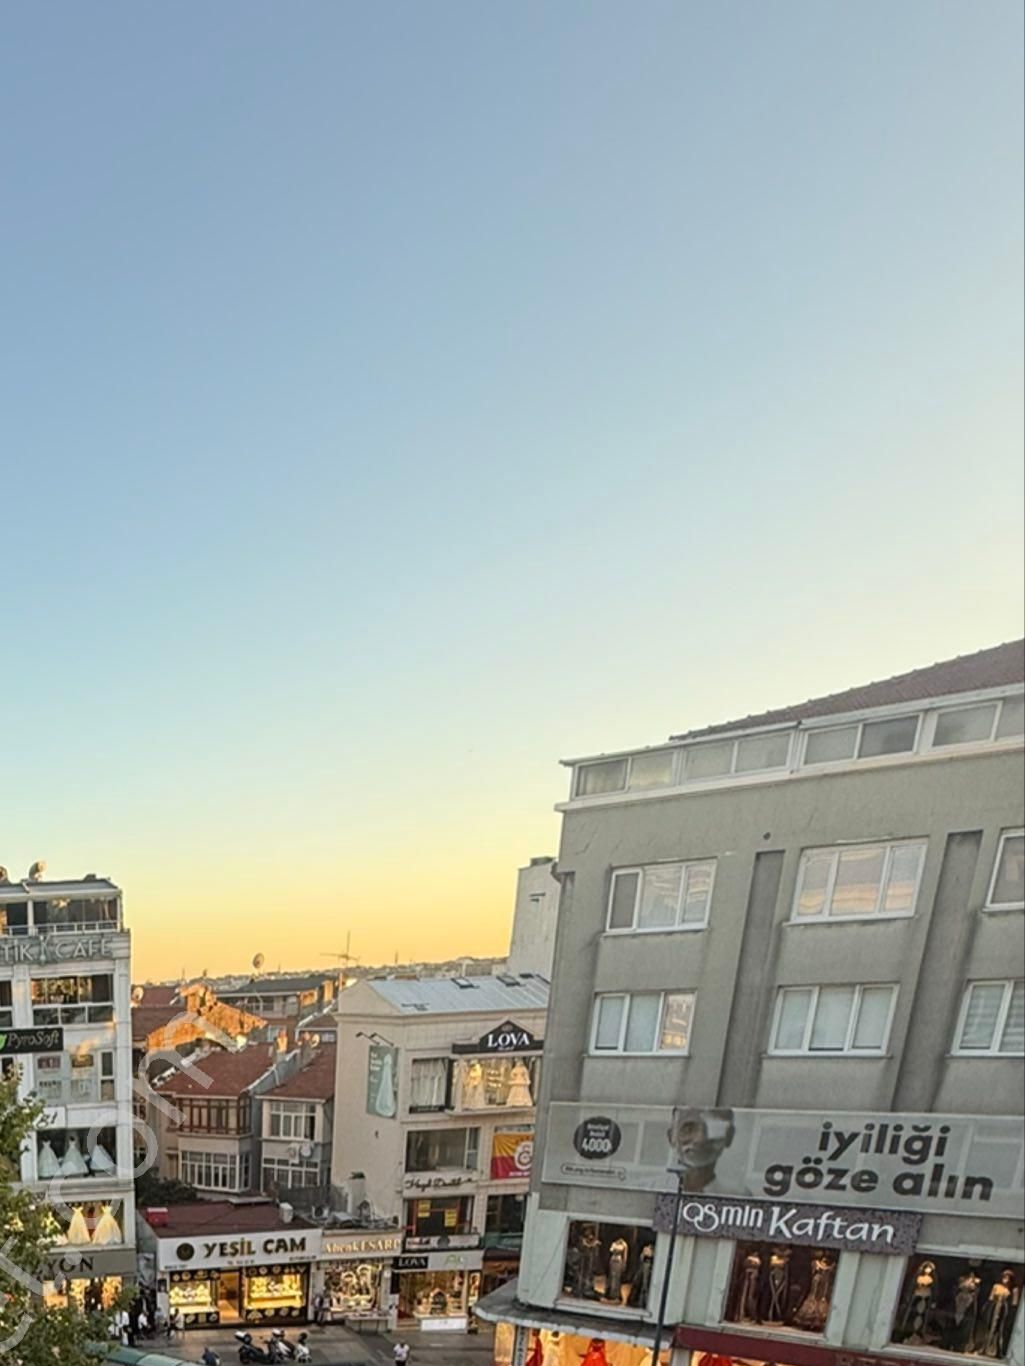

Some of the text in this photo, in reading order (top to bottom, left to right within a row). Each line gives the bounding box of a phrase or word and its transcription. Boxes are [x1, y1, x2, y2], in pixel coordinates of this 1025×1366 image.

[487, 1031, 531, 1048] LOVA
[818, 1120, 952, 1168] iyiliği
[762, 1155, 995, 1202] göze alın
[768, 1206, 895, 1245] Kaftan
[203, 1236, 307, 1260] YEŞİL CAM
